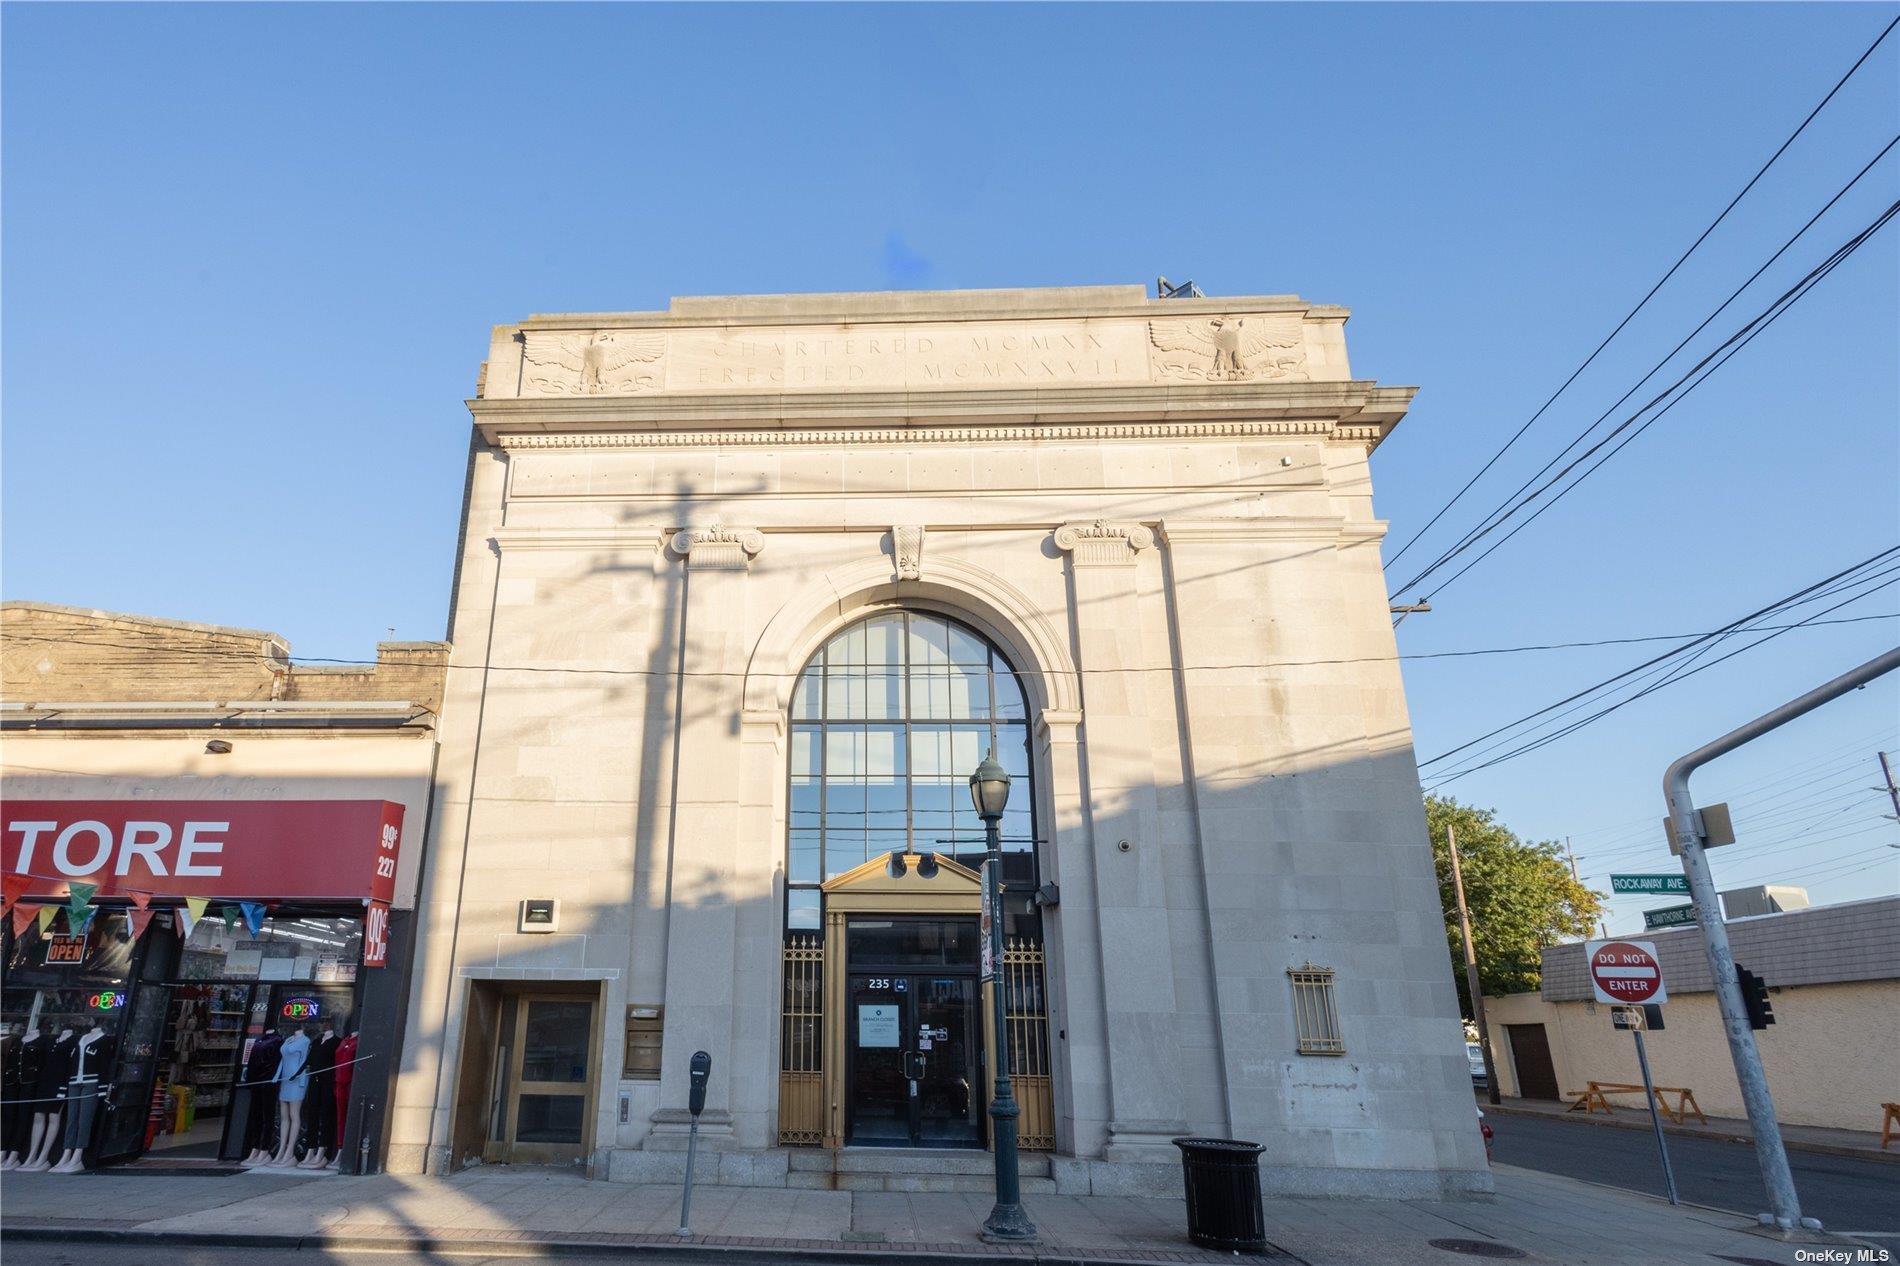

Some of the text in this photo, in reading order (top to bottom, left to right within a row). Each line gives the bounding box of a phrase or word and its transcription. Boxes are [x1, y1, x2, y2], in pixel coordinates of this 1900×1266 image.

[713, 333, 1103, 357] CHARTERED MCMXX
[698, 358, 1120, 384] ERECTED MCMXXVII
[8, 820, 230, 877] TORE
[377, 855, 395, 878] 227
[1613, 878, 1687, 890] ROCKAWAY AVE.
[1651, 909, 1685, 925] HAWTHORNE
[49, 945, 82, 960] OPEN
[1599, 954, 1646, 964] DO NOT
[869, 979, 889, 989] 235
[1609, 980, 1648, 991] ENTER
[90, 994, 125, 1008] OPEN
[284, 1003, 318, 1016] OPEN
